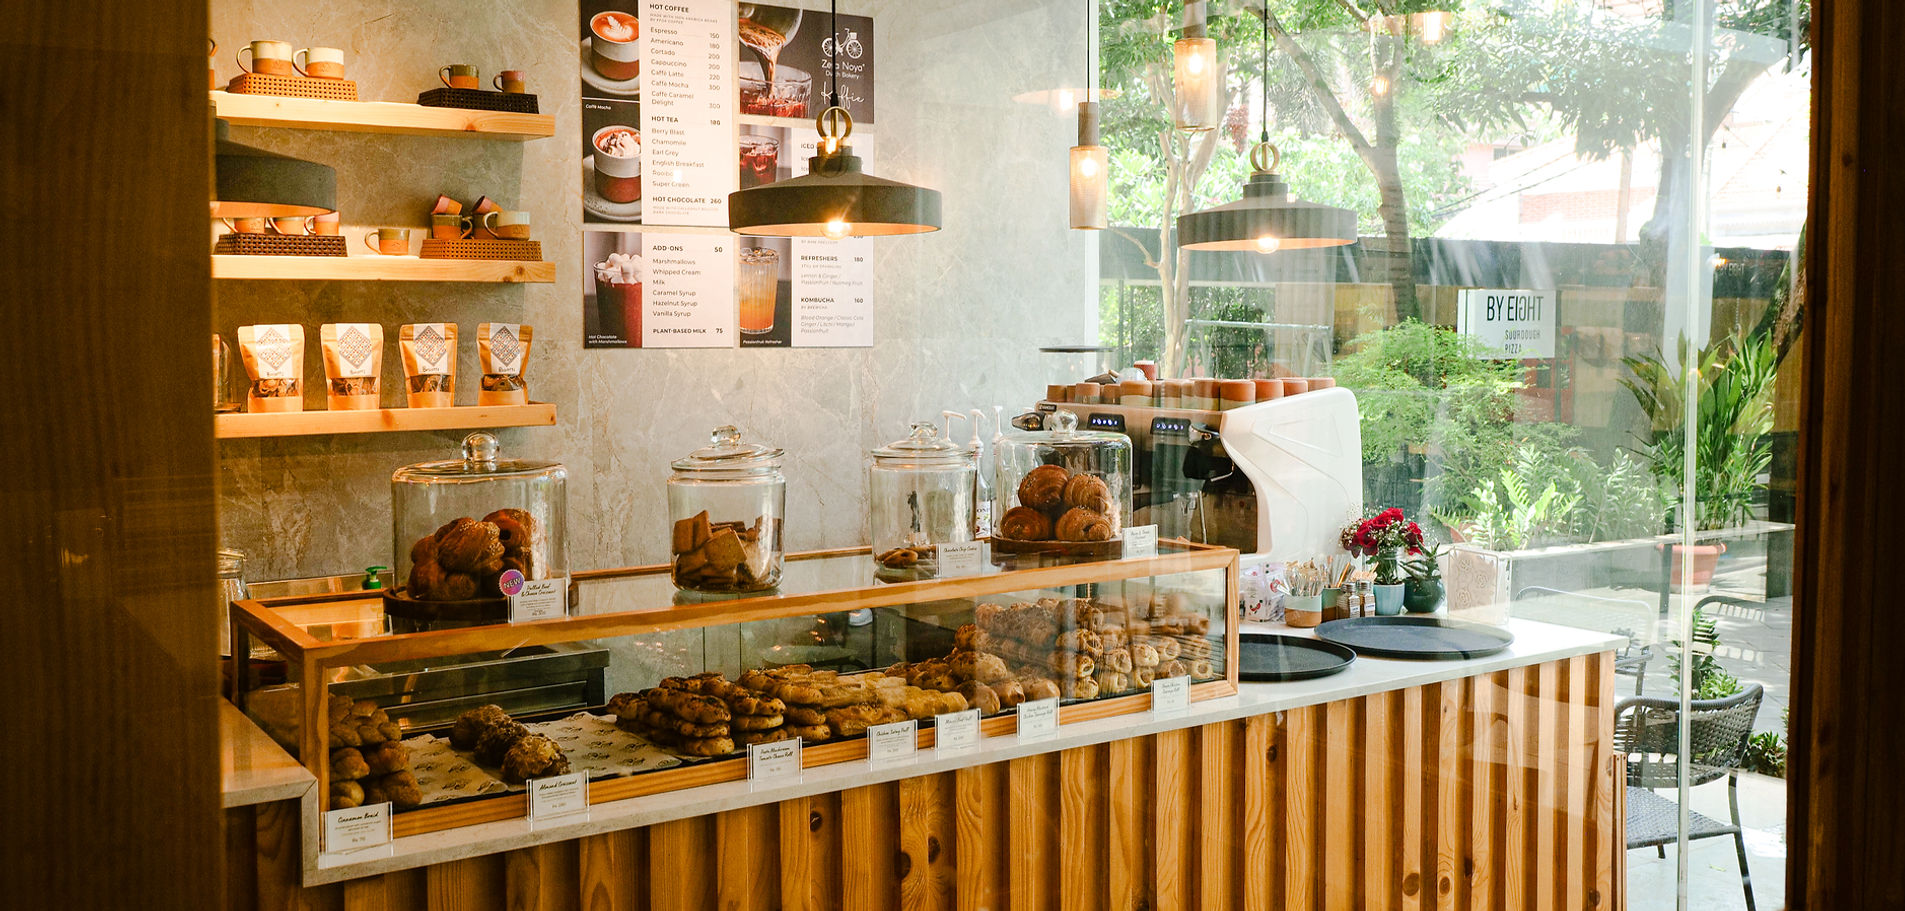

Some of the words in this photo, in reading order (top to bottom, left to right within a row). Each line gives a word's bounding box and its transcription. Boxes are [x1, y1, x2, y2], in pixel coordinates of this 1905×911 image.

[651, 27, 678, 35] Espresso
[651, 38, 683, 46] Americano
[651, 59, 687, 67] Cappuccino
[1487, 296, 1504, 321] BY
[1507, 296, 1544, 321] EIGHT
[1505, 344, 1521, 354] PIZZA
[504, 577, 520, 589] NEW
[539, 782, 557, 791] Almond
